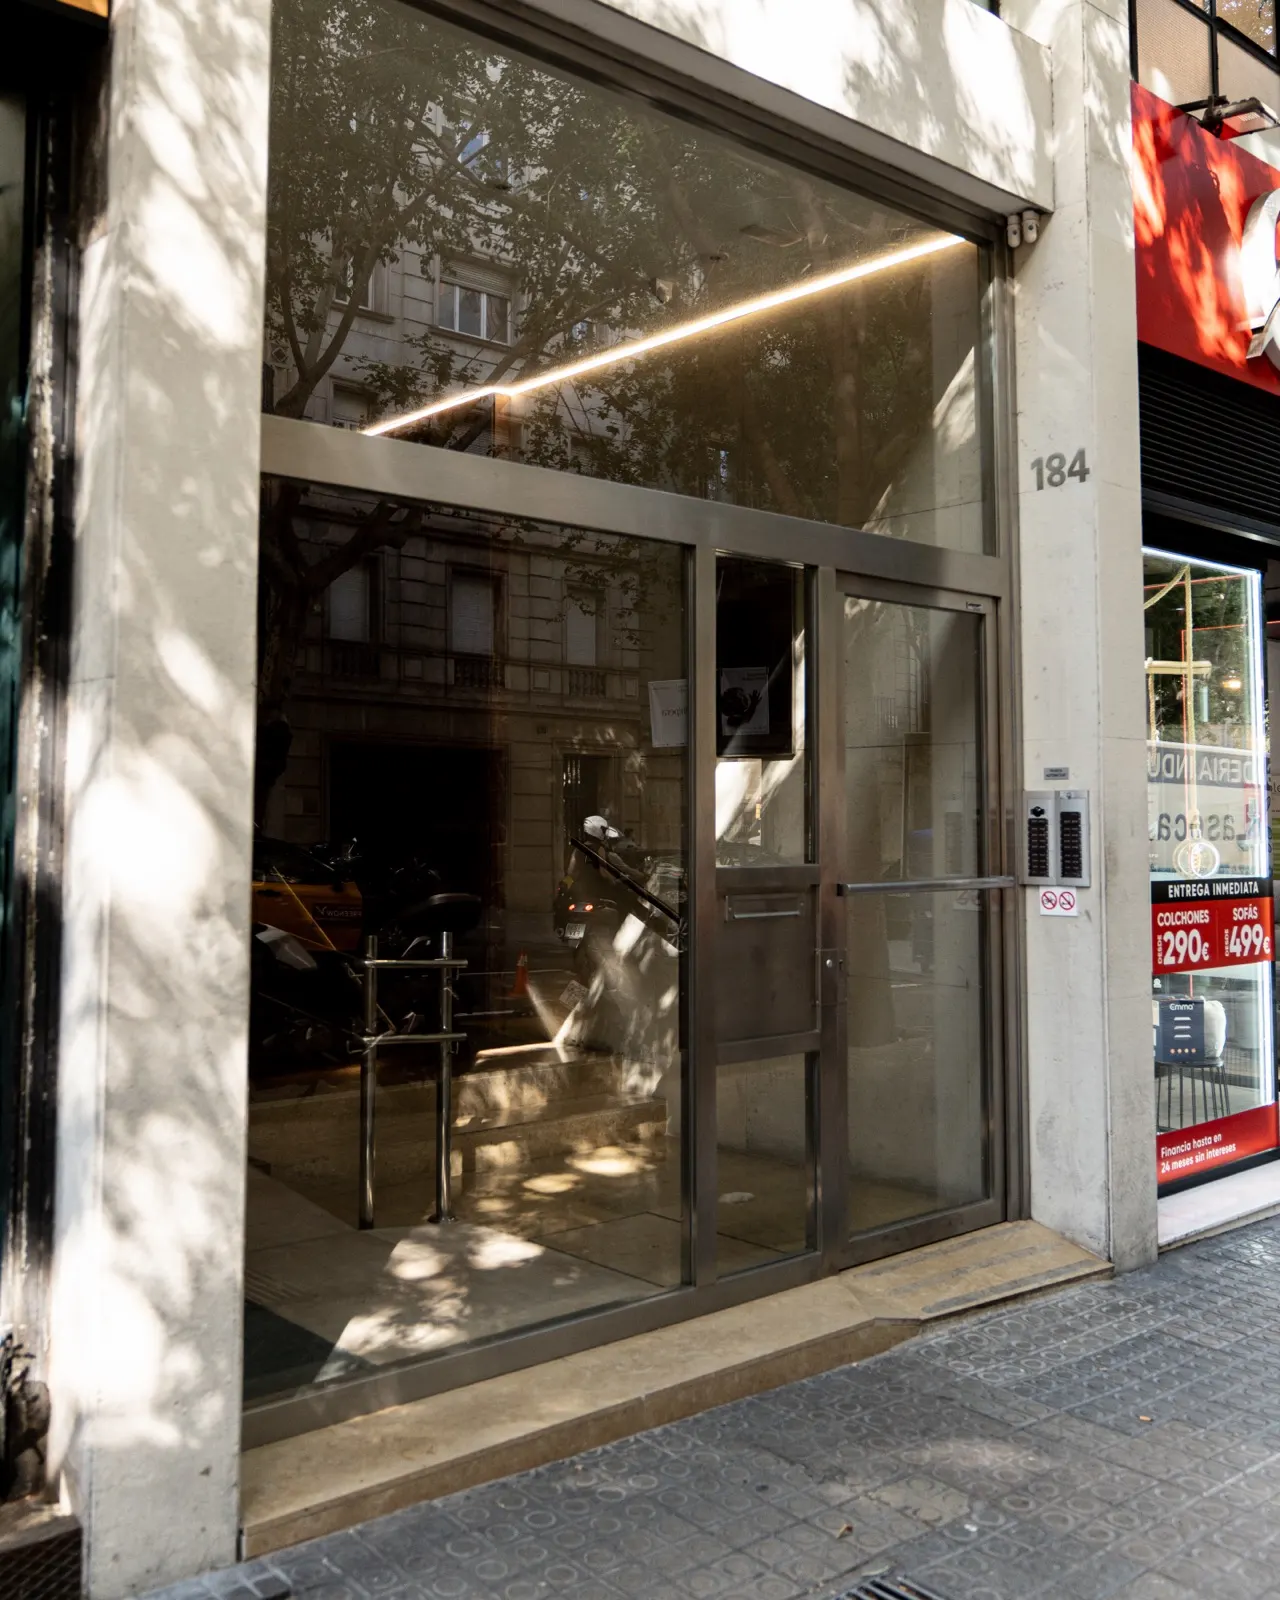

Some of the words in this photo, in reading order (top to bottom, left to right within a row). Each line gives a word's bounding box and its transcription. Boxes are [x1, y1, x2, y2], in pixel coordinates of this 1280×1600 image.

[1031, 448, 1090, 491] 184
[1168, 883, 1210, 898] ENTREGA
[1213, 881, 1259, 896] INMEDIATA
[1157, 909, 1209, 926] COLCHONES
[1232, 904, 1258, 921] SOFÁS
[1163, 929, 1209, 965] 290€
[1229, 923, 1270, 957] 499€
[1161, 1141, 1191, 1158] Financia
[1192, 1136, 1212, 1149] hasta
[1213, 1133, 1222, 1143] en
[1161, 1161, 1170, 1174] 24
[1171, 1156, 1194, 1170] meses
[1195, 1152, 1205, 1163] sin
[1206, 1143, 1236, 1160] intereses
